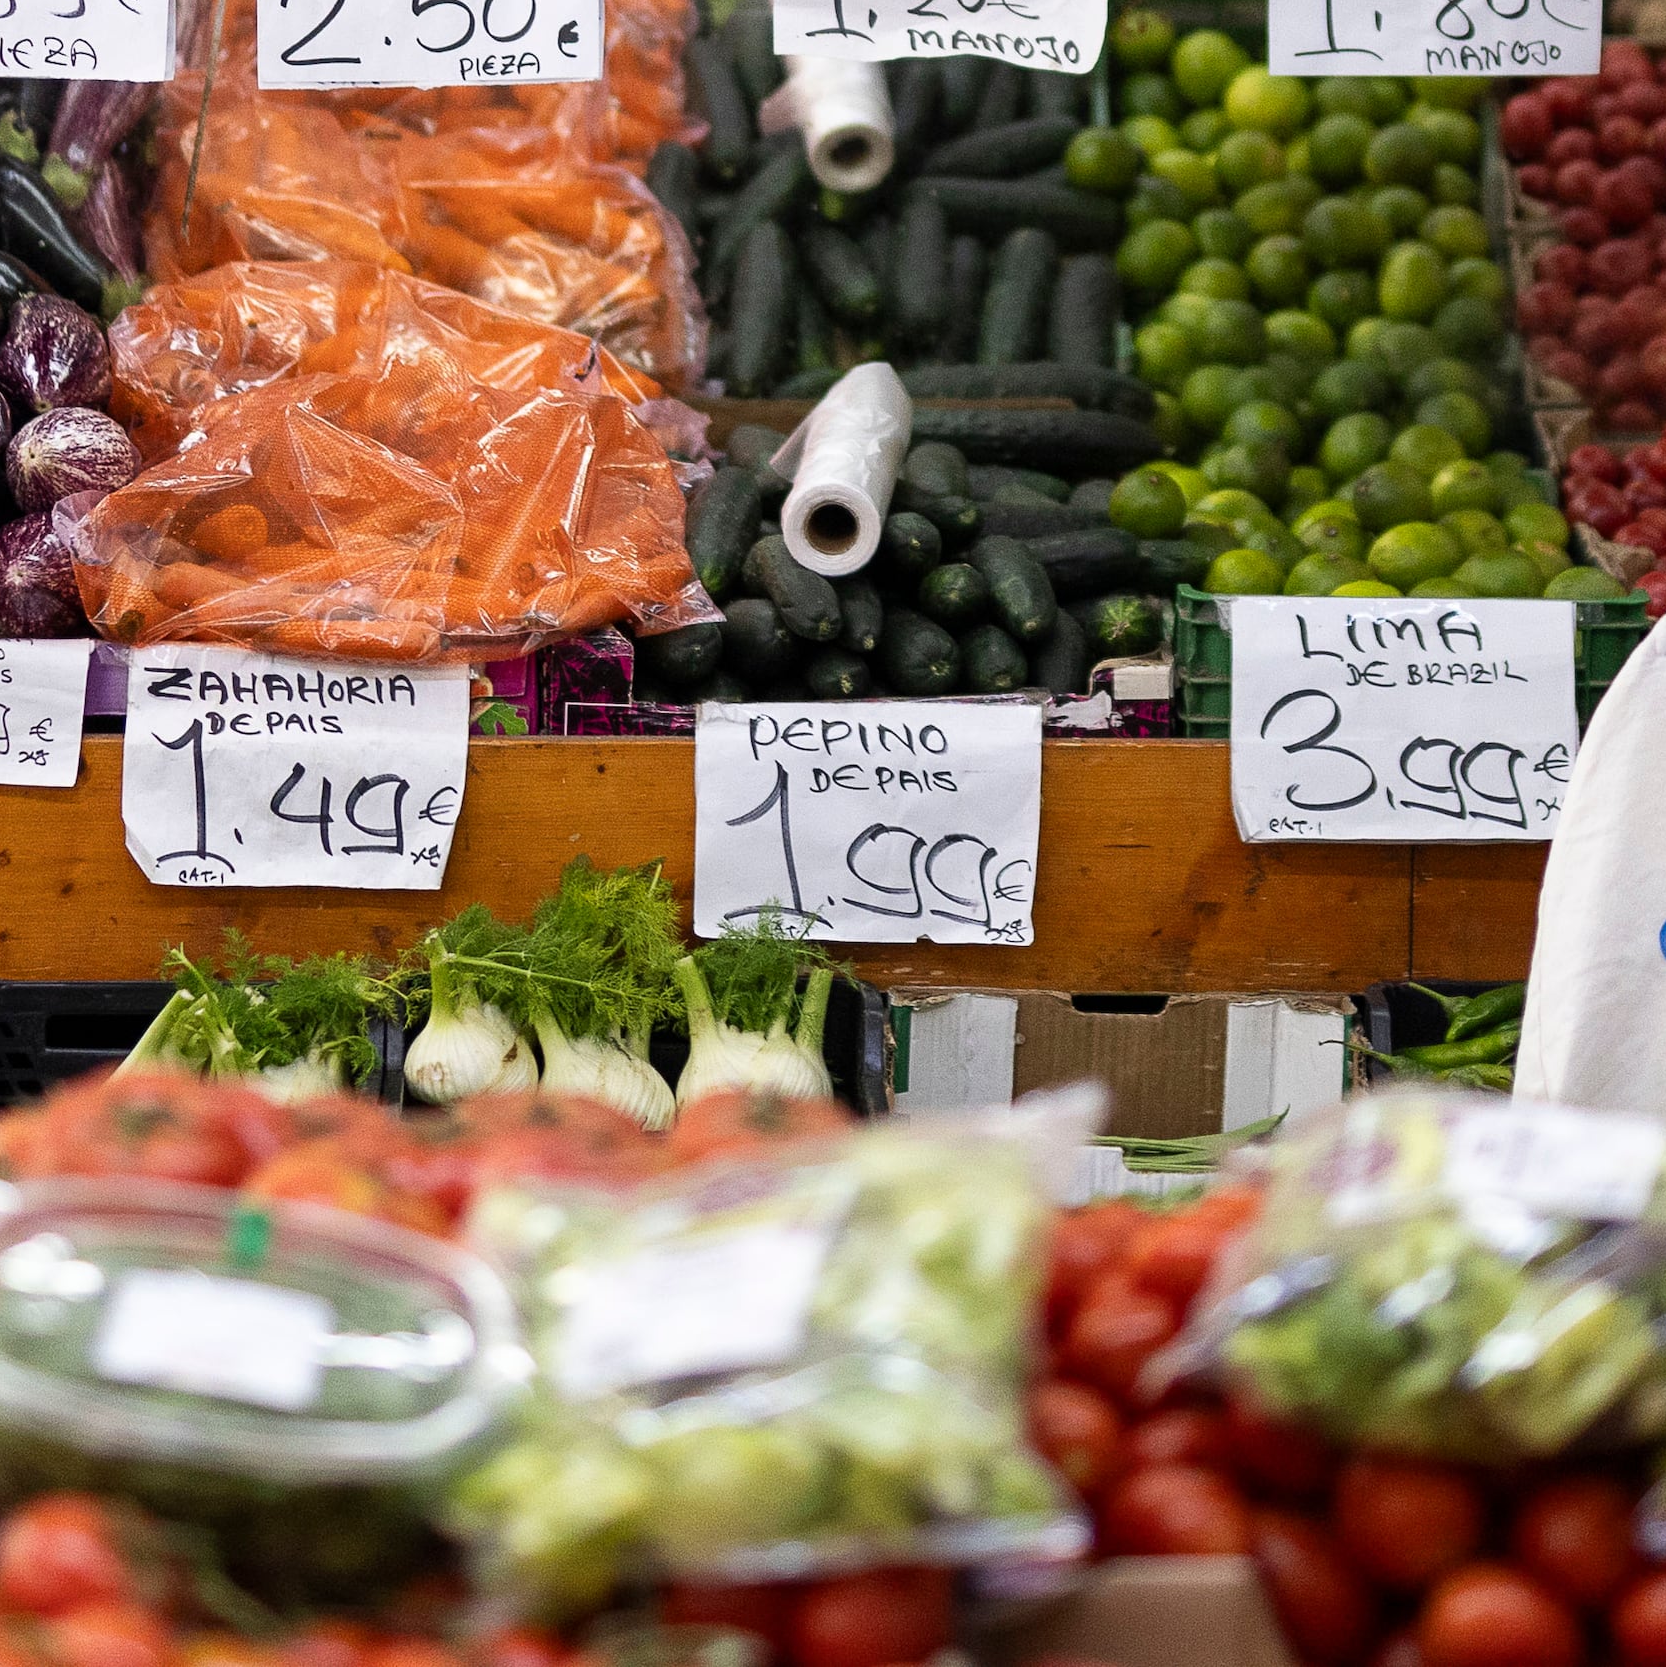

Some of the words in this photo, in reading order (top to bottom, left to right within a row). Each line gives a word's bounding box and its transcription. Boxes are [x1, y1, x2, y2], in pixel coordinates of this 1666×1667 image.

[906, 28, 1080, 65] MANOJO
[1426, 40, 1563, 73] MANOJO
[459, 52, 541, 81] PIEZA
[1295, 610, 1483, 662] LIMA
[1345, 661, 1397, 688] DE
[1406, 659, 1529, 686] BRAZIL
[205, 711, 262, 736] DE
[265, 712, 344, 735] PAIS
[748, 713, 949, 761] PEPINO
[809, 763, 871, 793] DE
[874, 765, 958, 794] PAIS
